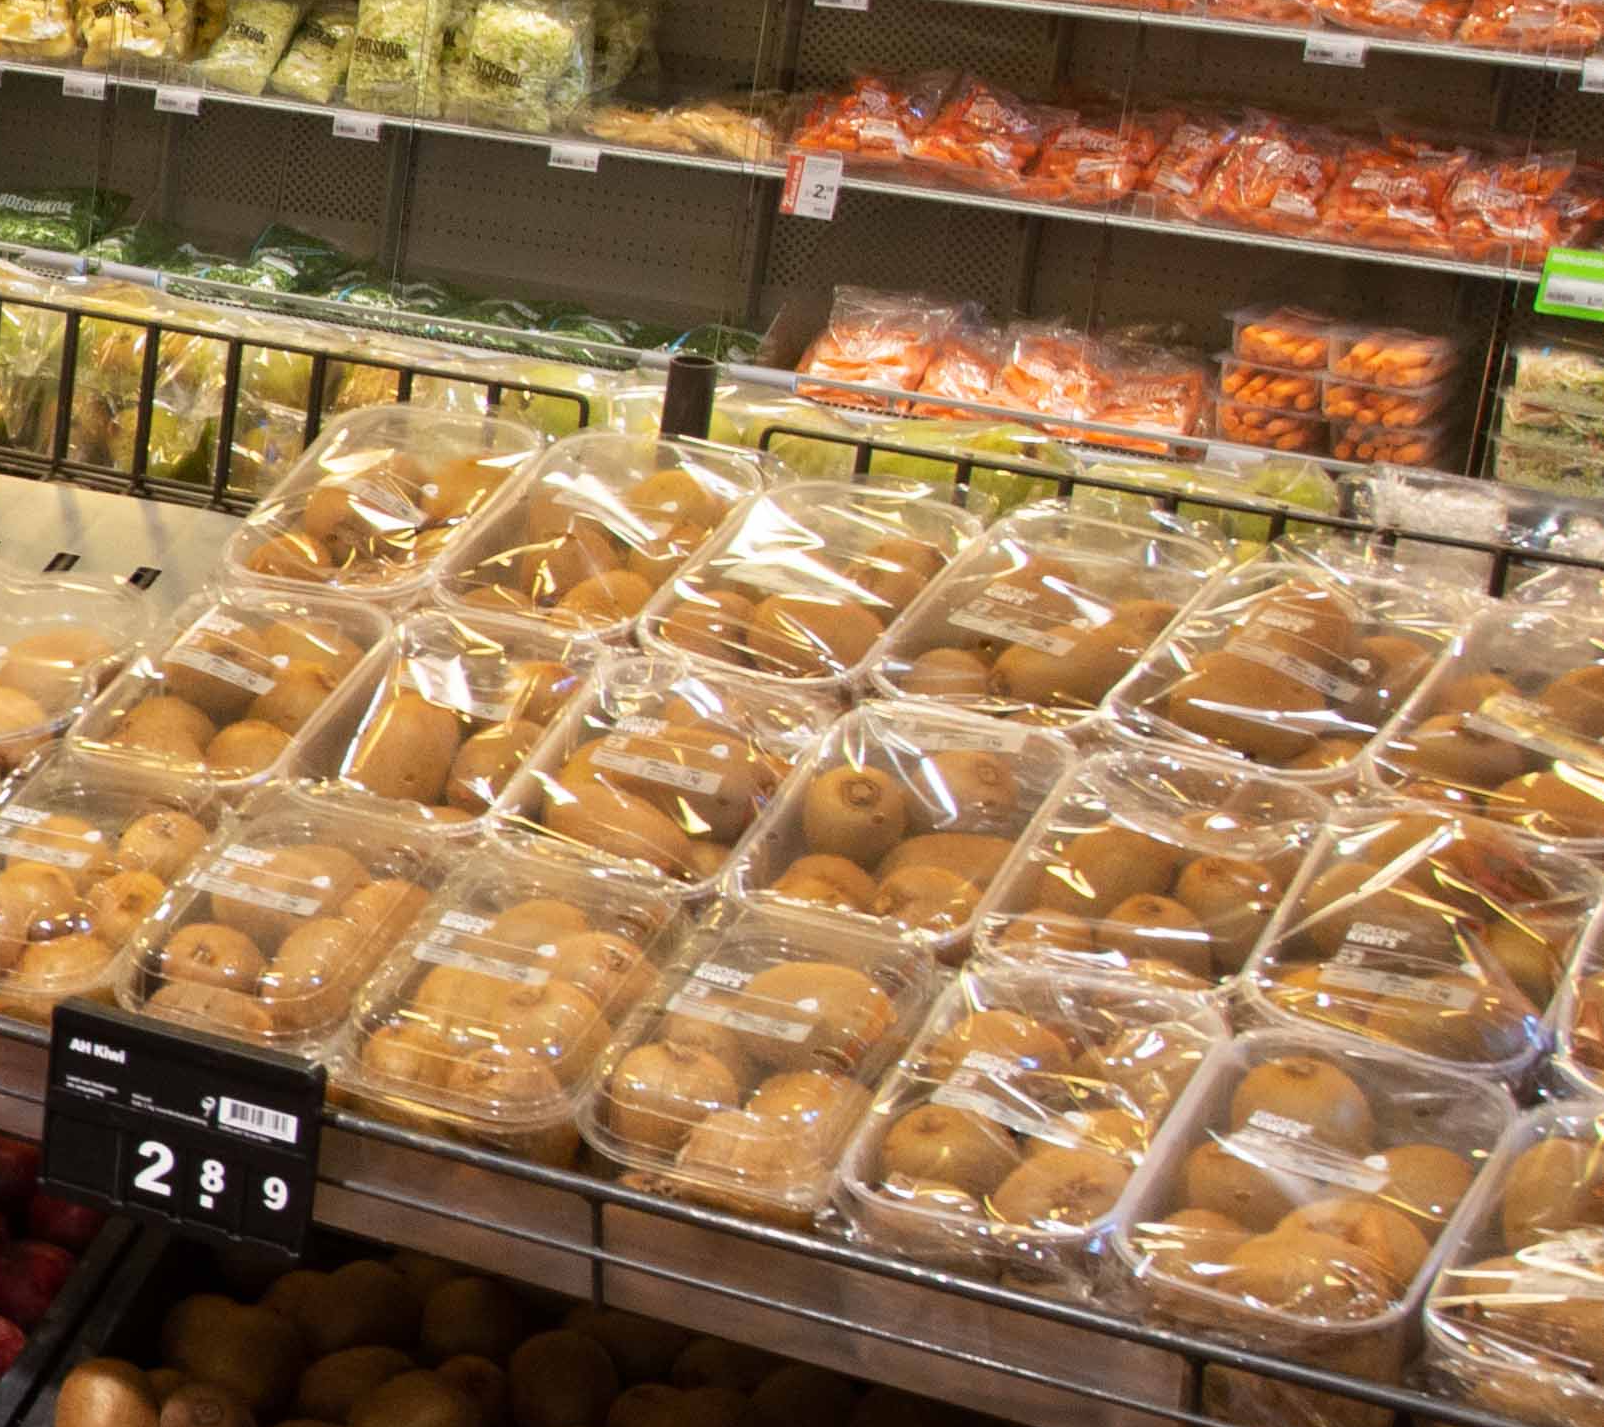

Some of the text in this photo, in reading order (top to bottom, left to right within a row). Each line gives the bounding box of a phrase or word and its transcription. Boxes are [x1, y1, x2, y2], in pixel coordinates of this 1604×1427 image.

[69, 1037, 126, 1065] AH Kiwi
[134, 1140, 288, 1212] 2.89
